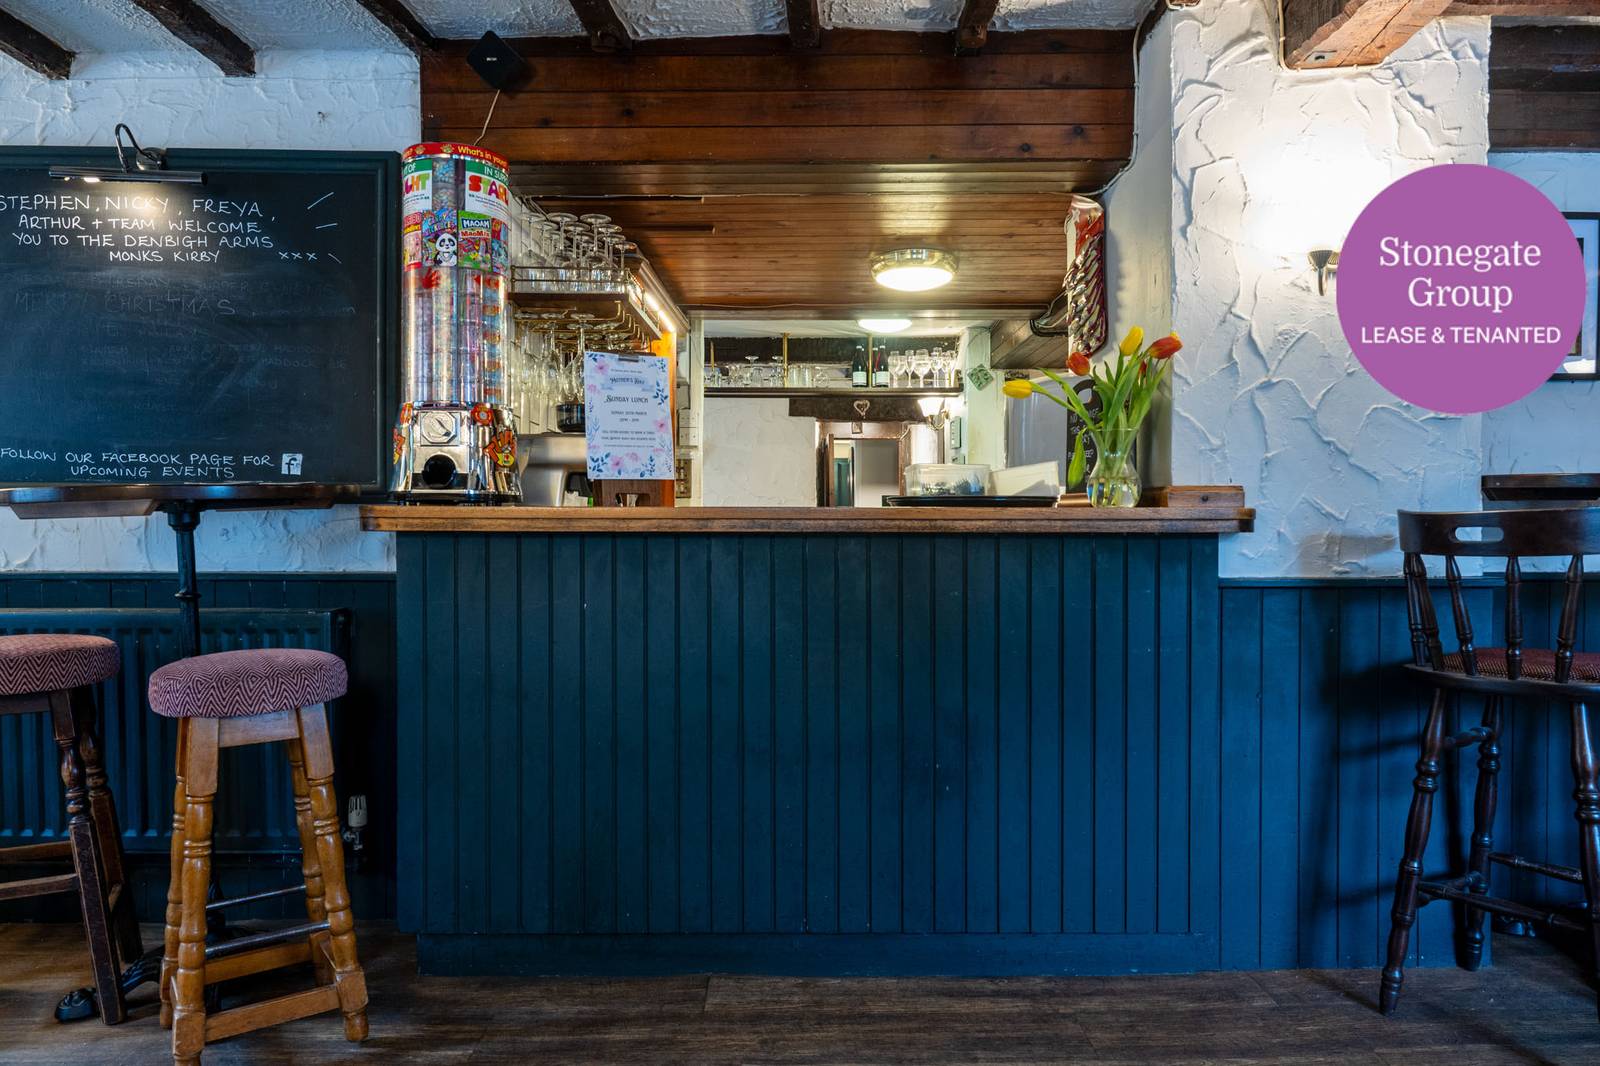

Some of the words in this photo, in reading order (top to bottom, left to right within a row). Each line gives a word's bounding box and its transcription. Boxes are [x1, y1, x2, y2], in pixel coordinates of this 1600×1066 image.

[458, 145, 484, 158] What's
[484, 150, 492, 160] in
[484, 166, 493, 176] IN
[19, 214, 86, 231] ARTHUR
[91, 218, 103, 230] +
[108, 217, 155, 231] TEAM
[168, 219, 262, 234] WELCOME
[462, 219, 491, 229] MAOAM
[12, 232, 42, 246] YOU
[49, 234, 69, 246] TO
[76, 233, 116, 247] THE
[124, 234, 208, 249] DENBIGH
[219, 236, 274, 249] ARMS
[109, 250, 164, 262] MONKS
[173, 250, 220, 264] KIRBY
[0, 447, 57, 462] FOLLOW
[65, 452, 95, 464] OUR
[102, 452, 183, 465] FACEBOOK
[190, 453, 236, 467] PAGE
[243, 454, 275, 467] FOR
[70, 465, 151, 478] UPCOMING
[162, 466, 235, 479] EVENTS
